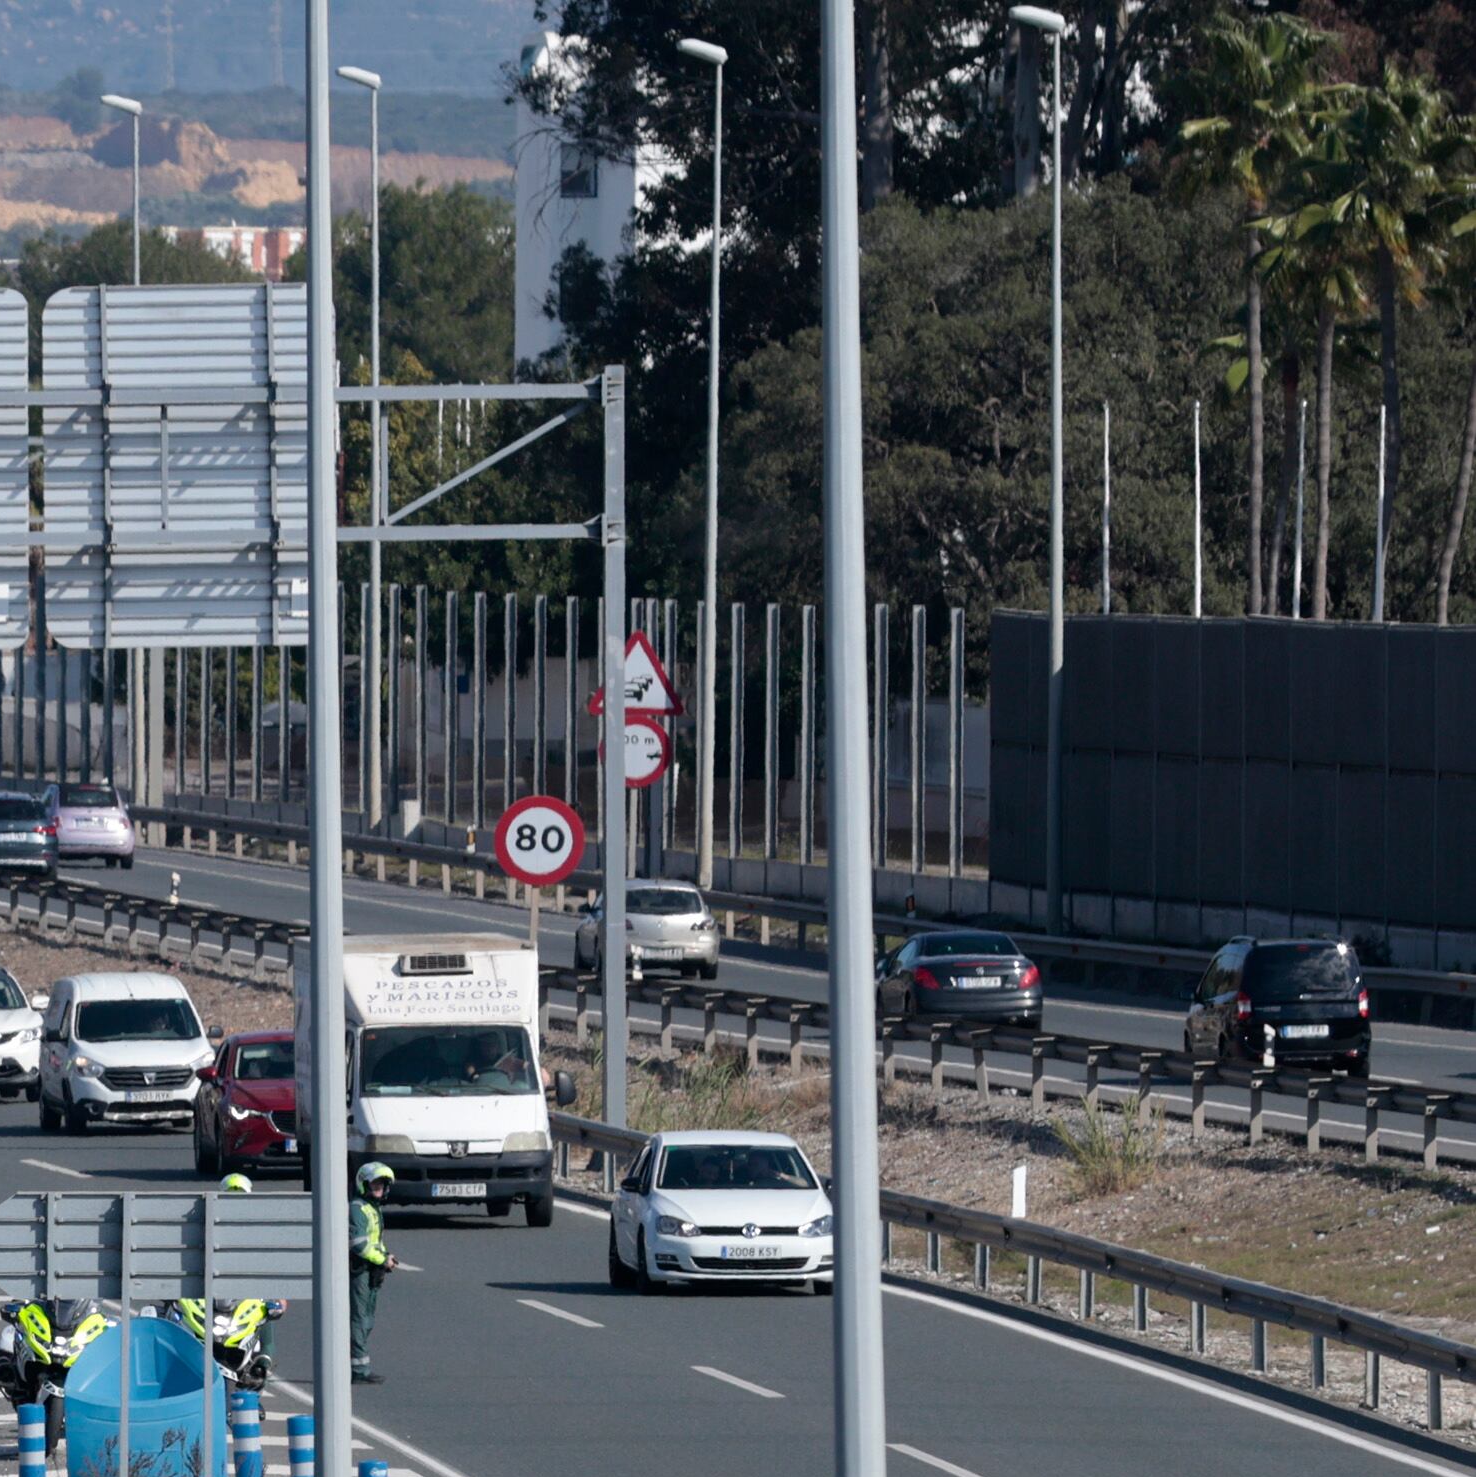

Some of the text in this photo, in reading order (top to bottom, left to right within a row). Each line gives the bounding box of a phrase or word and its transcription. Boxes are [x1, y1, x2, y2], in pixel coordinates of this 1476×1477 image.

[644, 737, 655, 745] m
[514, 823, 565, 853] 80
[375, 978, 508, 990] PESCADOS
[387, 989, 519, 1002] MARISCOS
[366, 1005, 403, 1015] Luis
[451, 1002, 521, 1016] Santiago
[439, 1184, 463, 1195] 7583
[729, 1247, 778, 1257] 2008 KSY
